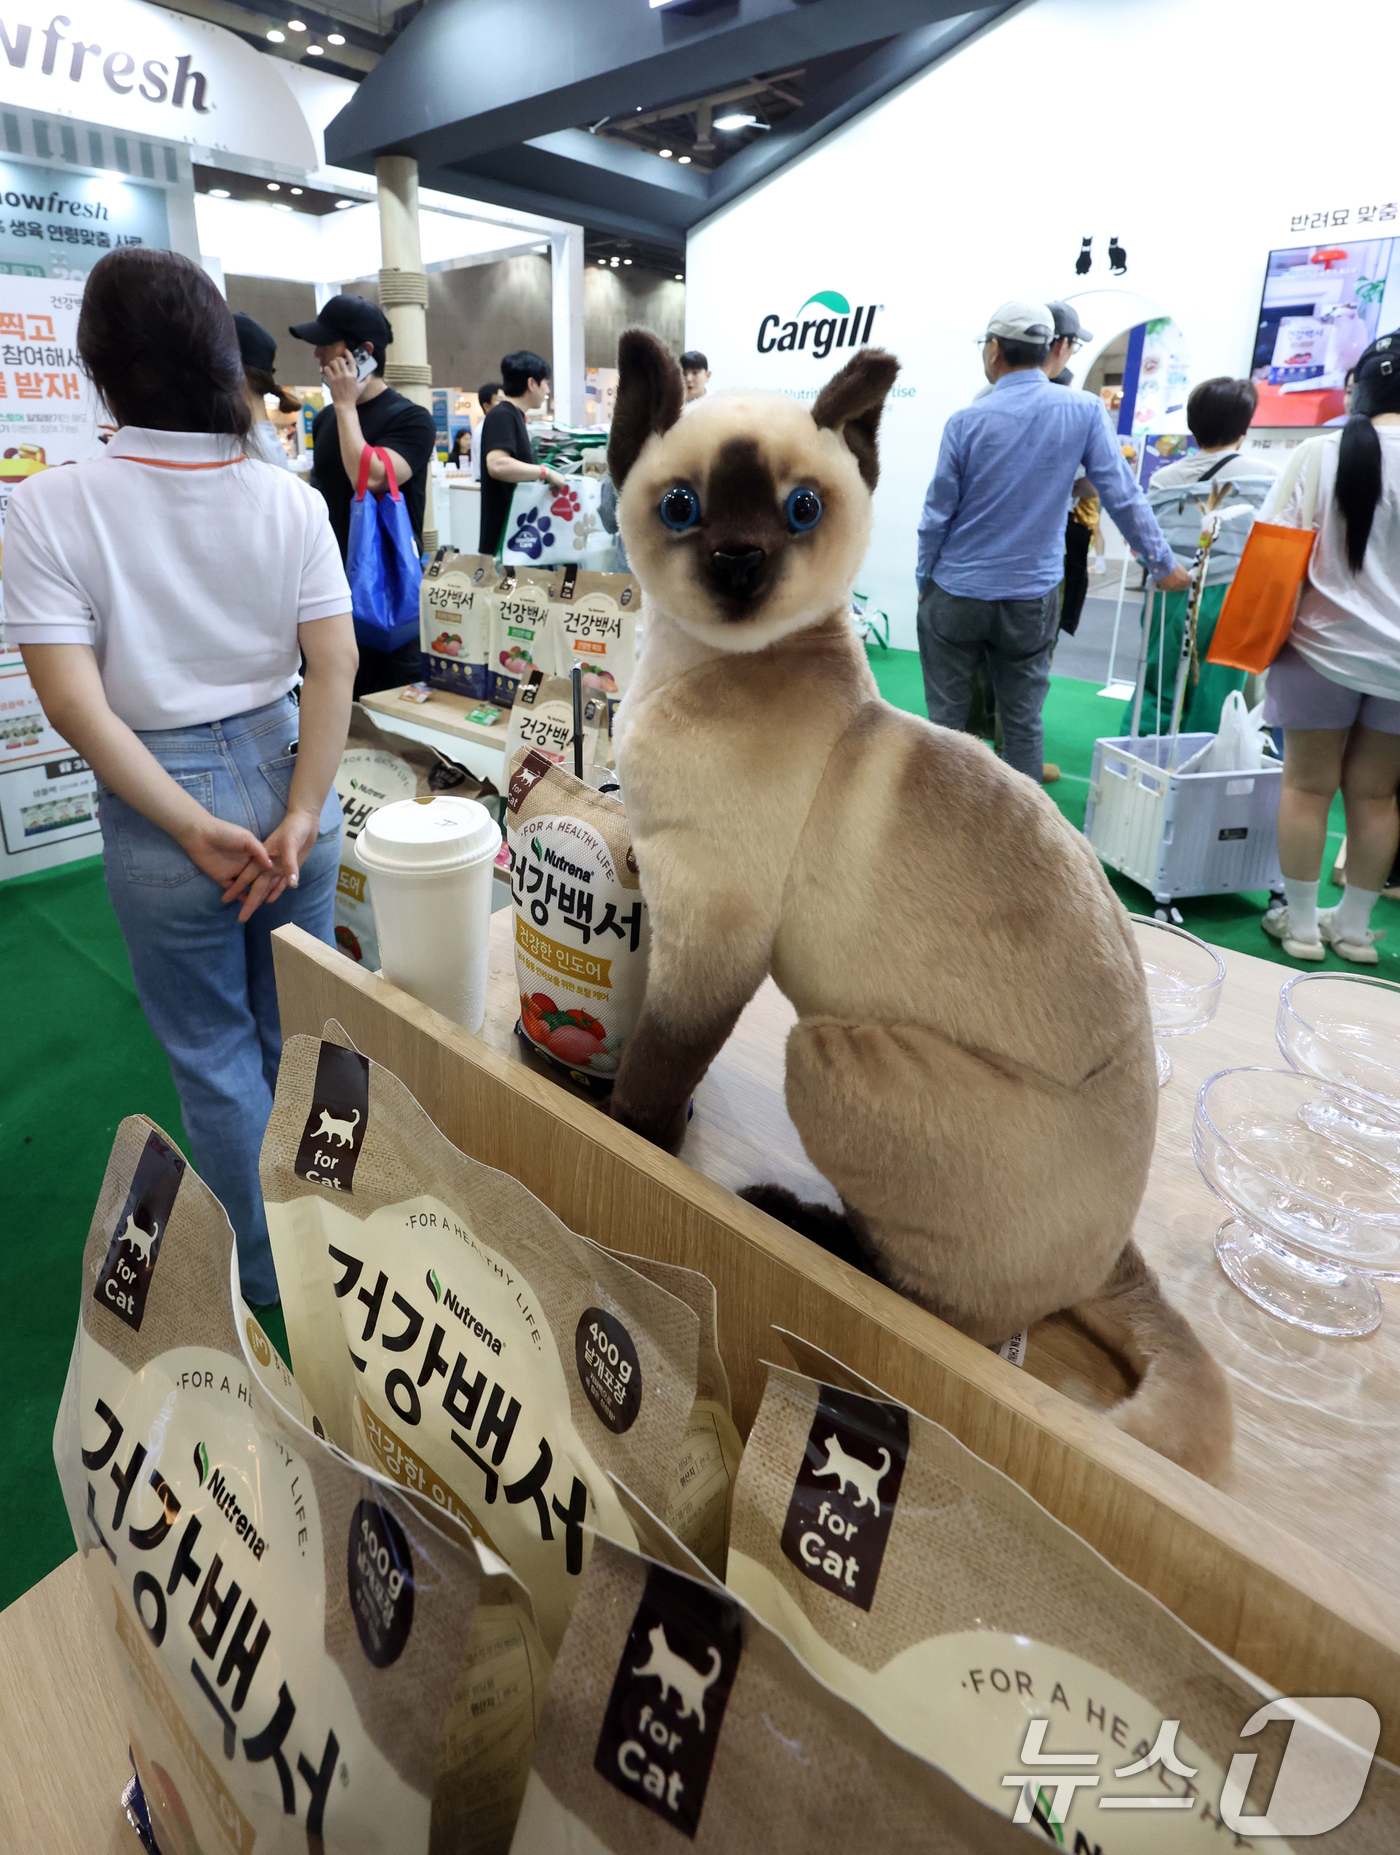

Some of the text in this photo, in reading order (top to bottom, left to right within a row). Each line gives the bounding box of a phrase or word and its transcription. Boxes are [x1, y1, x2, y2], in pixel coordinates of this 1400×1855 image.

[0, 191, 108, 221] owfresh
[1291, 202, 1398, 232] 반려묘 맞춤
[757, 305, 877, 359] Cargill
[428, 587, 475, 610] 건강백서
[500, 601, 550, 627] 건강백서
[563, 612, 622, 639] 건강백서
[520, 717, 585, 750] 건강백
[546, 821, 553, 830] A
[557, 821, 599, 851] HEALTHY
[544, 847, 592, 883] Nutrena
[509, 846, 642, 953] 건강백서
[520, 925, 552, 963] 건강한
[556, 949, 601, 981] 인도어
[314, 1150, 339, 1170] for
[305, 1170, 342, 1191] Cat
[116, 1258, 138, 1285] for
[442, 1217, 451, 1231] A
[454, 1224, 514, 1287] HEALTHY
[104, 1278, 136, 1316] Cat
[443, 1287, 502, 1357] Nutrena
[220, 1376, 230, 1393] A
[584, 1340, 627, 1406] 낱개포장
[328, 1243, 588, 1576] 건강백서
[366, 1413, 426, 1490] 건강한
[207, 1468, 266, 1562] Nutrena
[818, 1501, 858, 1542] for
[799, 1531, 860, 1588] Cat
[81, 1398, 340, 1855] 건강백서
[1050, 1682, 1071, 1712] A
[638, 1705, 682, 1754] for
[617, 1740, 684, 1812] Cat
